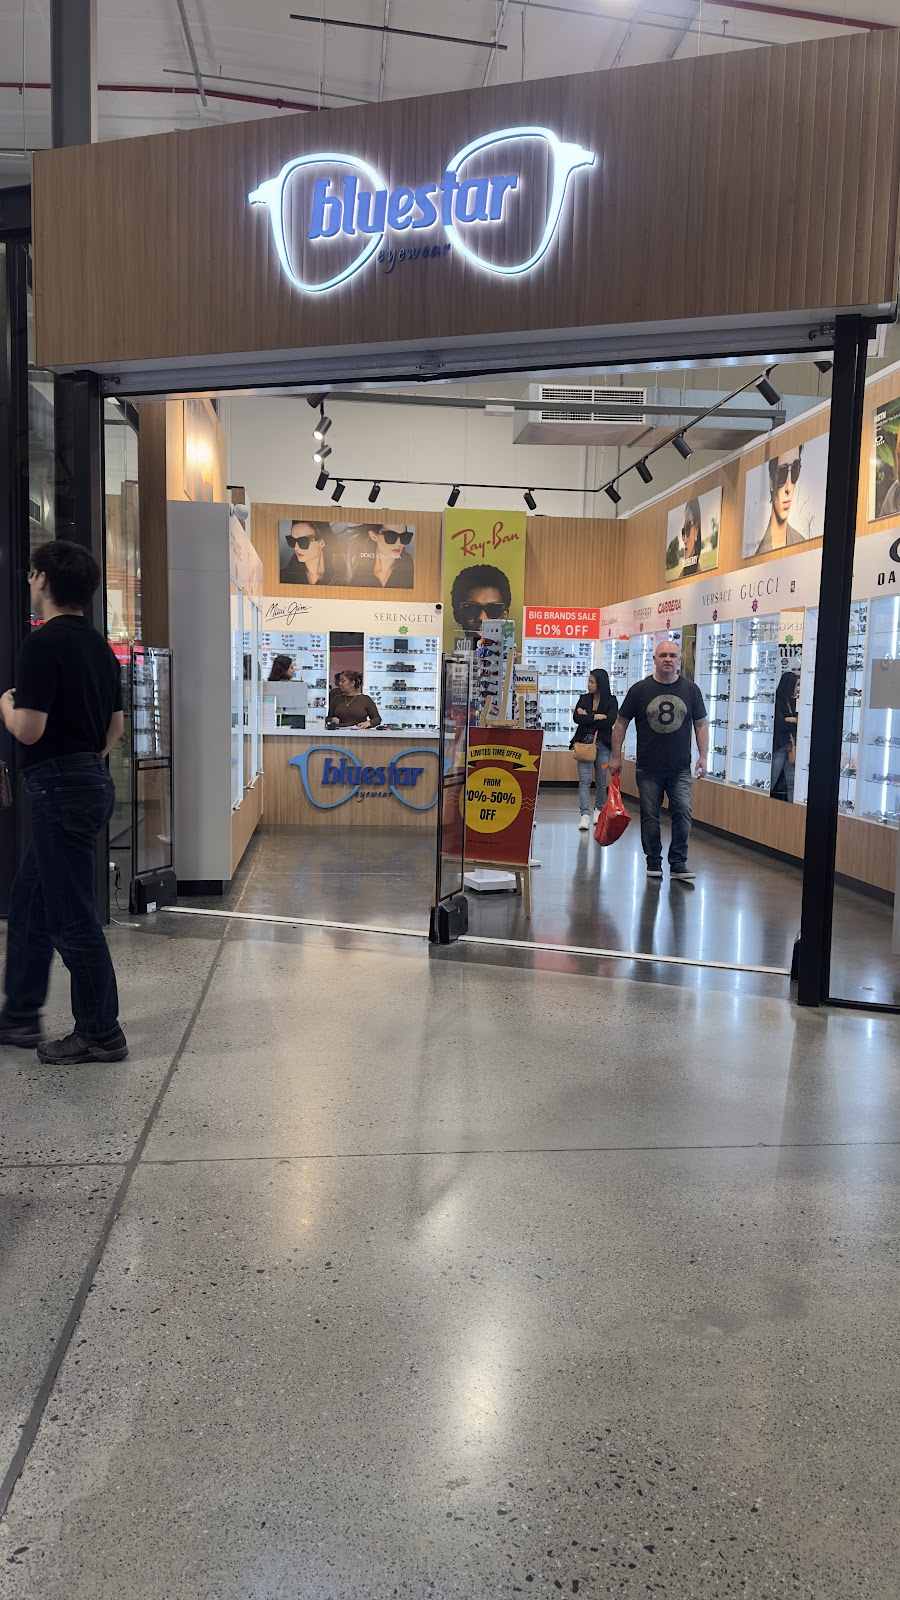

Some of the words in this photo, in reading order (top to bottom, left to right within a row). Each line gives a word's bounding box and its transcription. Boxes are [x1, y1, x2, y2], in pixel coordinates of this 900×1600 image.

[307, 170, 519, 241] bluestar
[378, 243, 451, 273] eyewear
[740, 577, 779, 600] GUCCI
[702, 589, 732, 606] VERSACE
[265, 603, 287, 618] Maui
[286, 601, 312, 626] Jim
[657, 599, 682, 615] CARRERA
[374, 613, 433, 623] SERENGETI
[528, 611, 543, 620] BIG
[543, 611, 576, 620] BRANDS
[577, 612, 597, 621] SALE
[535, 623, 561, 636] 50%
[565, 624, 589, 637] OFF
[657, 701, 675, 726] 8
[470, 748, 491, 758] LIMITED
[492, 748, 506, 757] TIME
[506, 750, 523, 760] OFFER
[321, 757, 425, 787] bluestar
[483, 778, 502, 787] FROM
[354, 791, 394, 803] eyewear
[466, 790, 516, 805] 0%-50%
[479, 808, 497, 821] OFF
